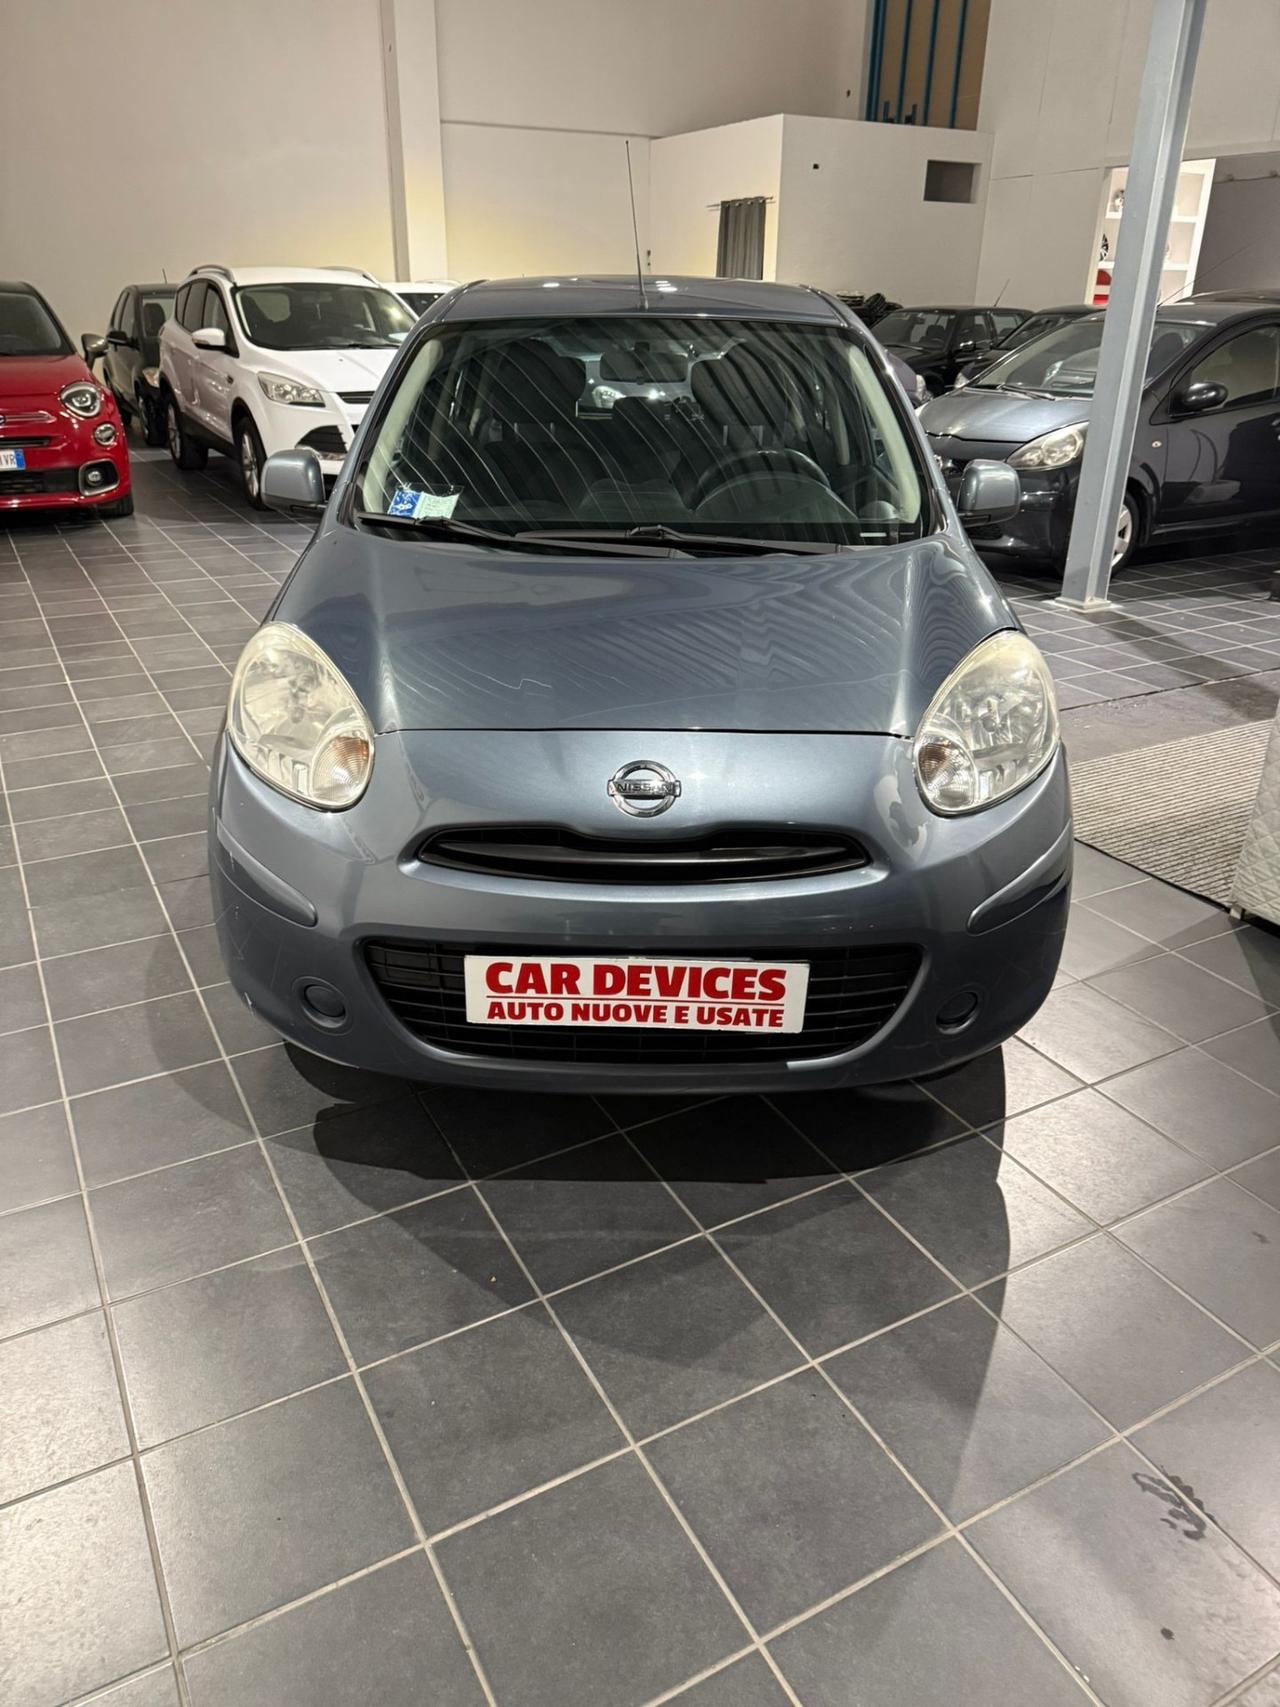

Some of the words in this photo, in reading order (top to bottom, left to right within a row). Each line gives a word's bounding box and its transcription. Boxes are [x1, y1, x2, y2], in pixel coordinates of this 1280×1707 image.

[616, 782, 676, 794] NISSAN
[486, 962, 581, 995] CAR
[593, 964, 787, 1001] DEVICES
[487, 1001, 564, 1021] AUTO
[571, 1003, 668, 1024] NUOVE
[674, 1005, 690, 1024] E
[696, 1006, 784, 1028] USATE
